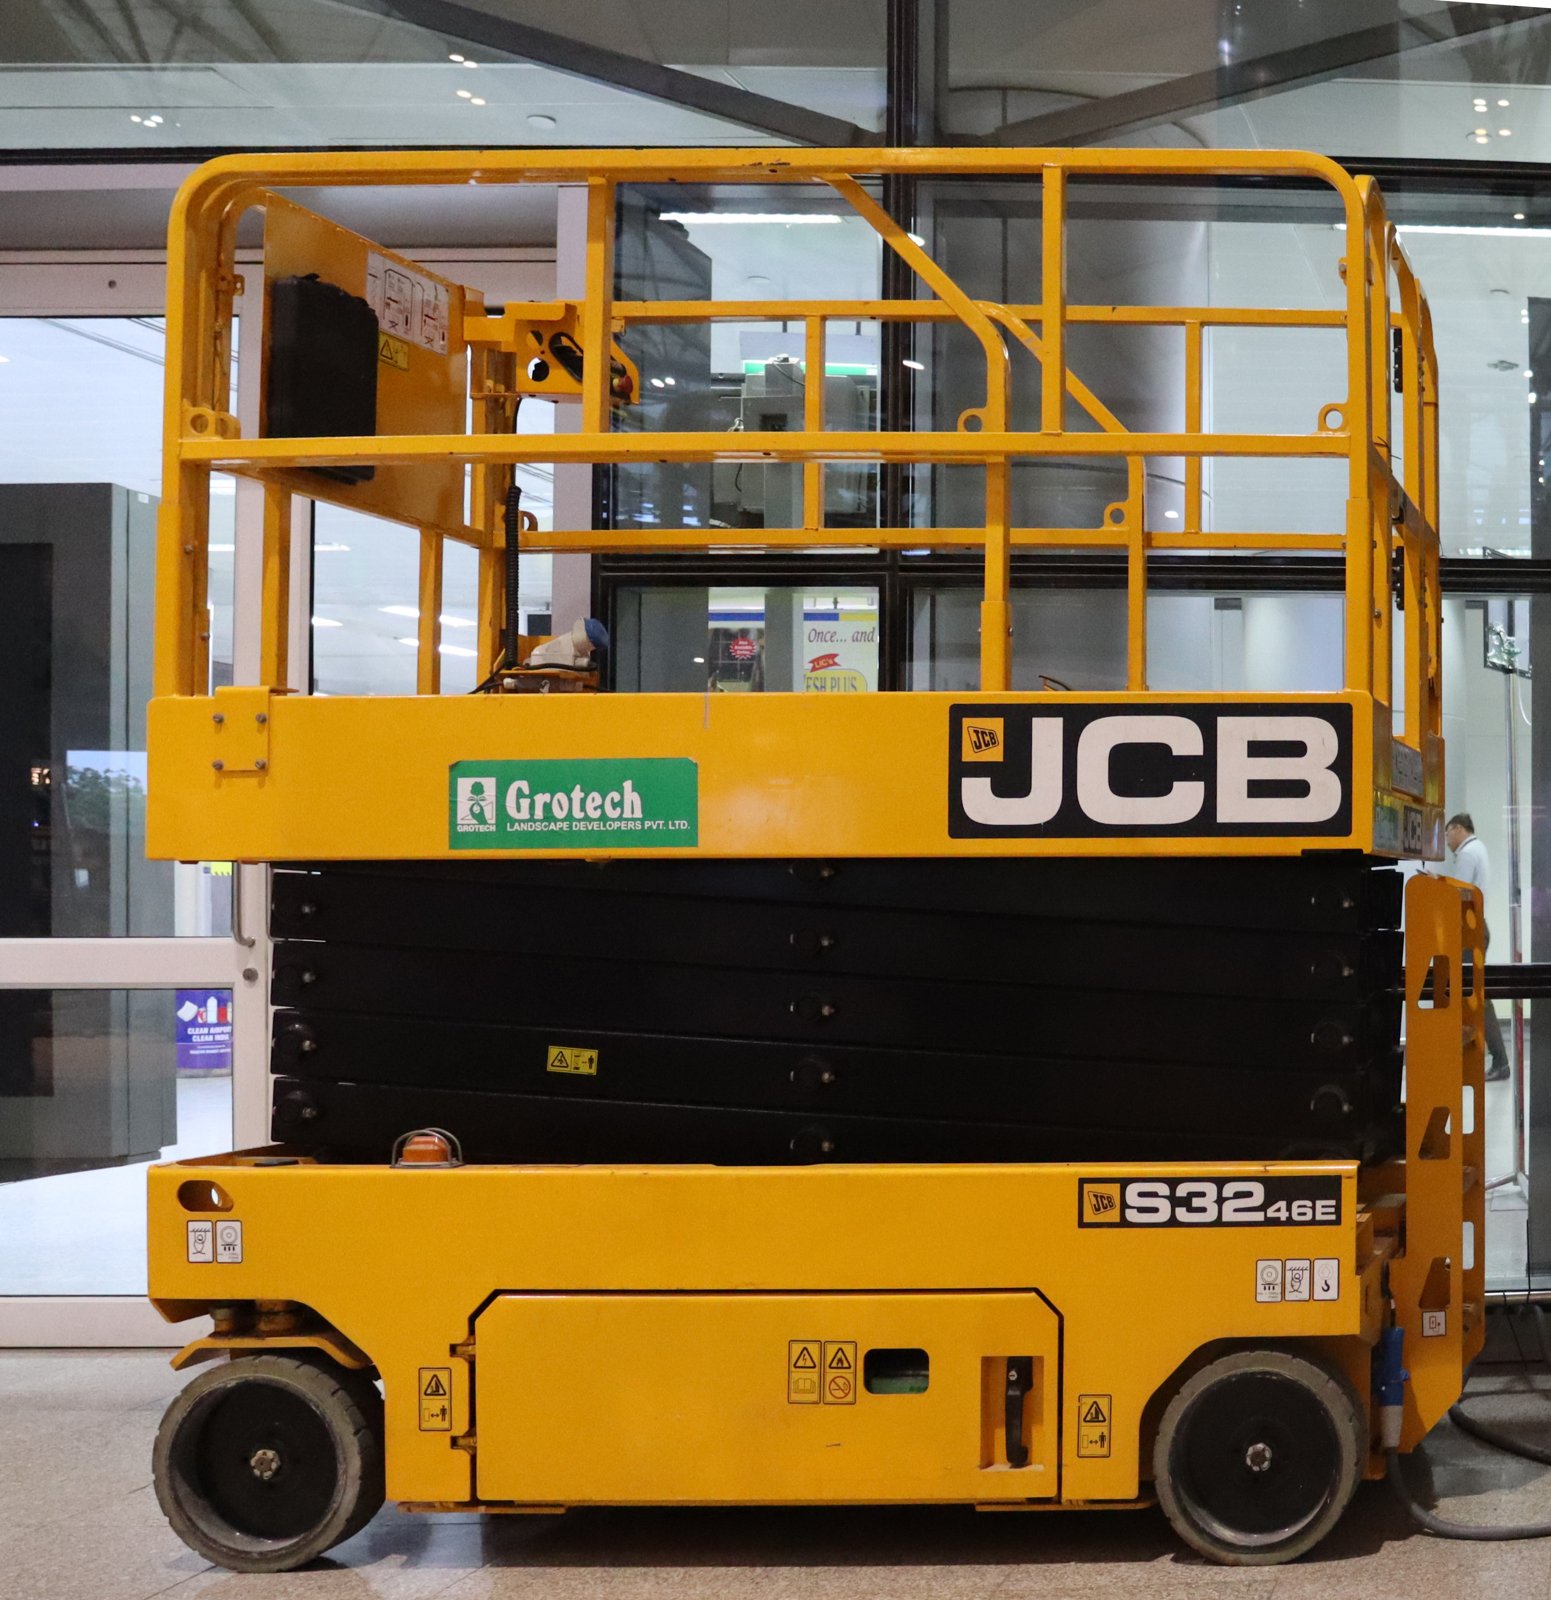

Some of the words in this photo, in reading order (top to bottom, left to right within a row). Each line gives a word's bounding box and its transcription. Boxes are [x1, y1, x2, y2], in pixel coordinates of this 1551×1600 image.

[851, 626, 876, 643] and
[972, 728, 998, 751] JCB
[961, 715, 1342, 825] JCB
[505, 779, 643, 820] Grotech
[457, 824, 496, 833] GROTECH
[506, 821, 570, 832] LANDSCAPE
[572, 820, 642, 831] DEVELOPERS
[644, 820, 666, 830] PVT.
[668, 820, 691, 830] LTD.
[1093, 1192, 1116, 1213] JCB
